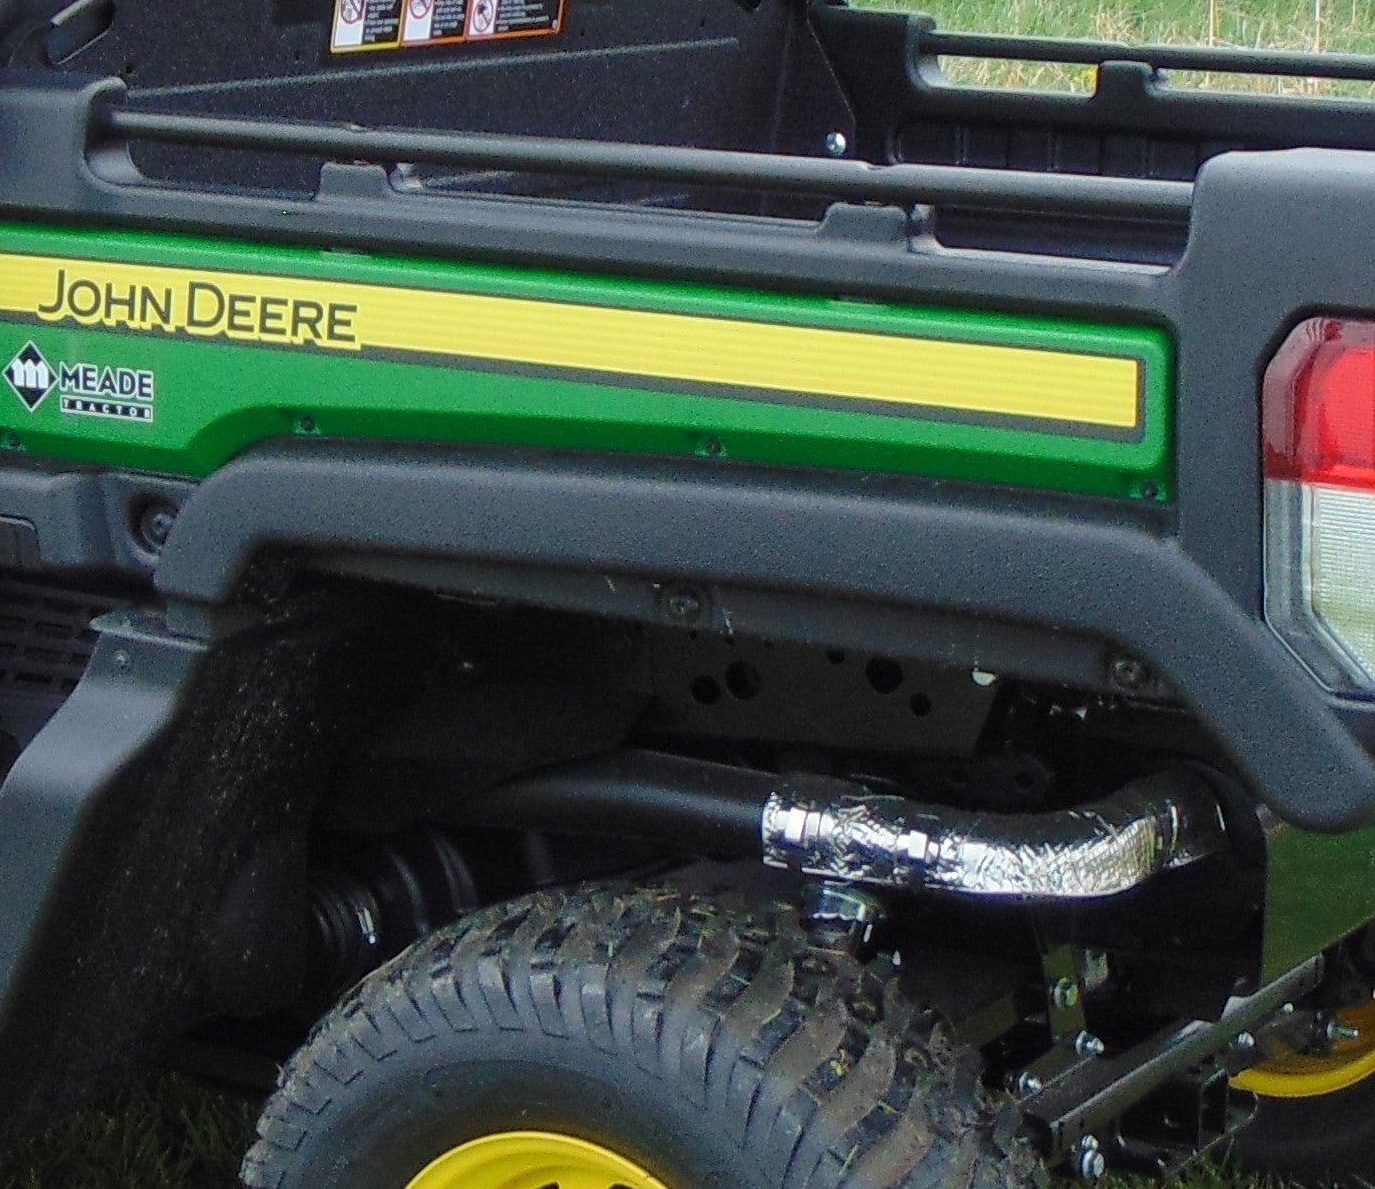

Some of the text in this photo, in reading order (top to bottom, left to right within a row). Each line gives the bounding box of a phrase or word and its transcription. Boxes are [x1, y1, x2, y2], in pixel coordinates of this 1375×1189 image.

[38, 268, 358, 342] JOHN DEERE
[60, 362, 153, 400] MEADE
[62, 398, 152, 420] TRACTOR
